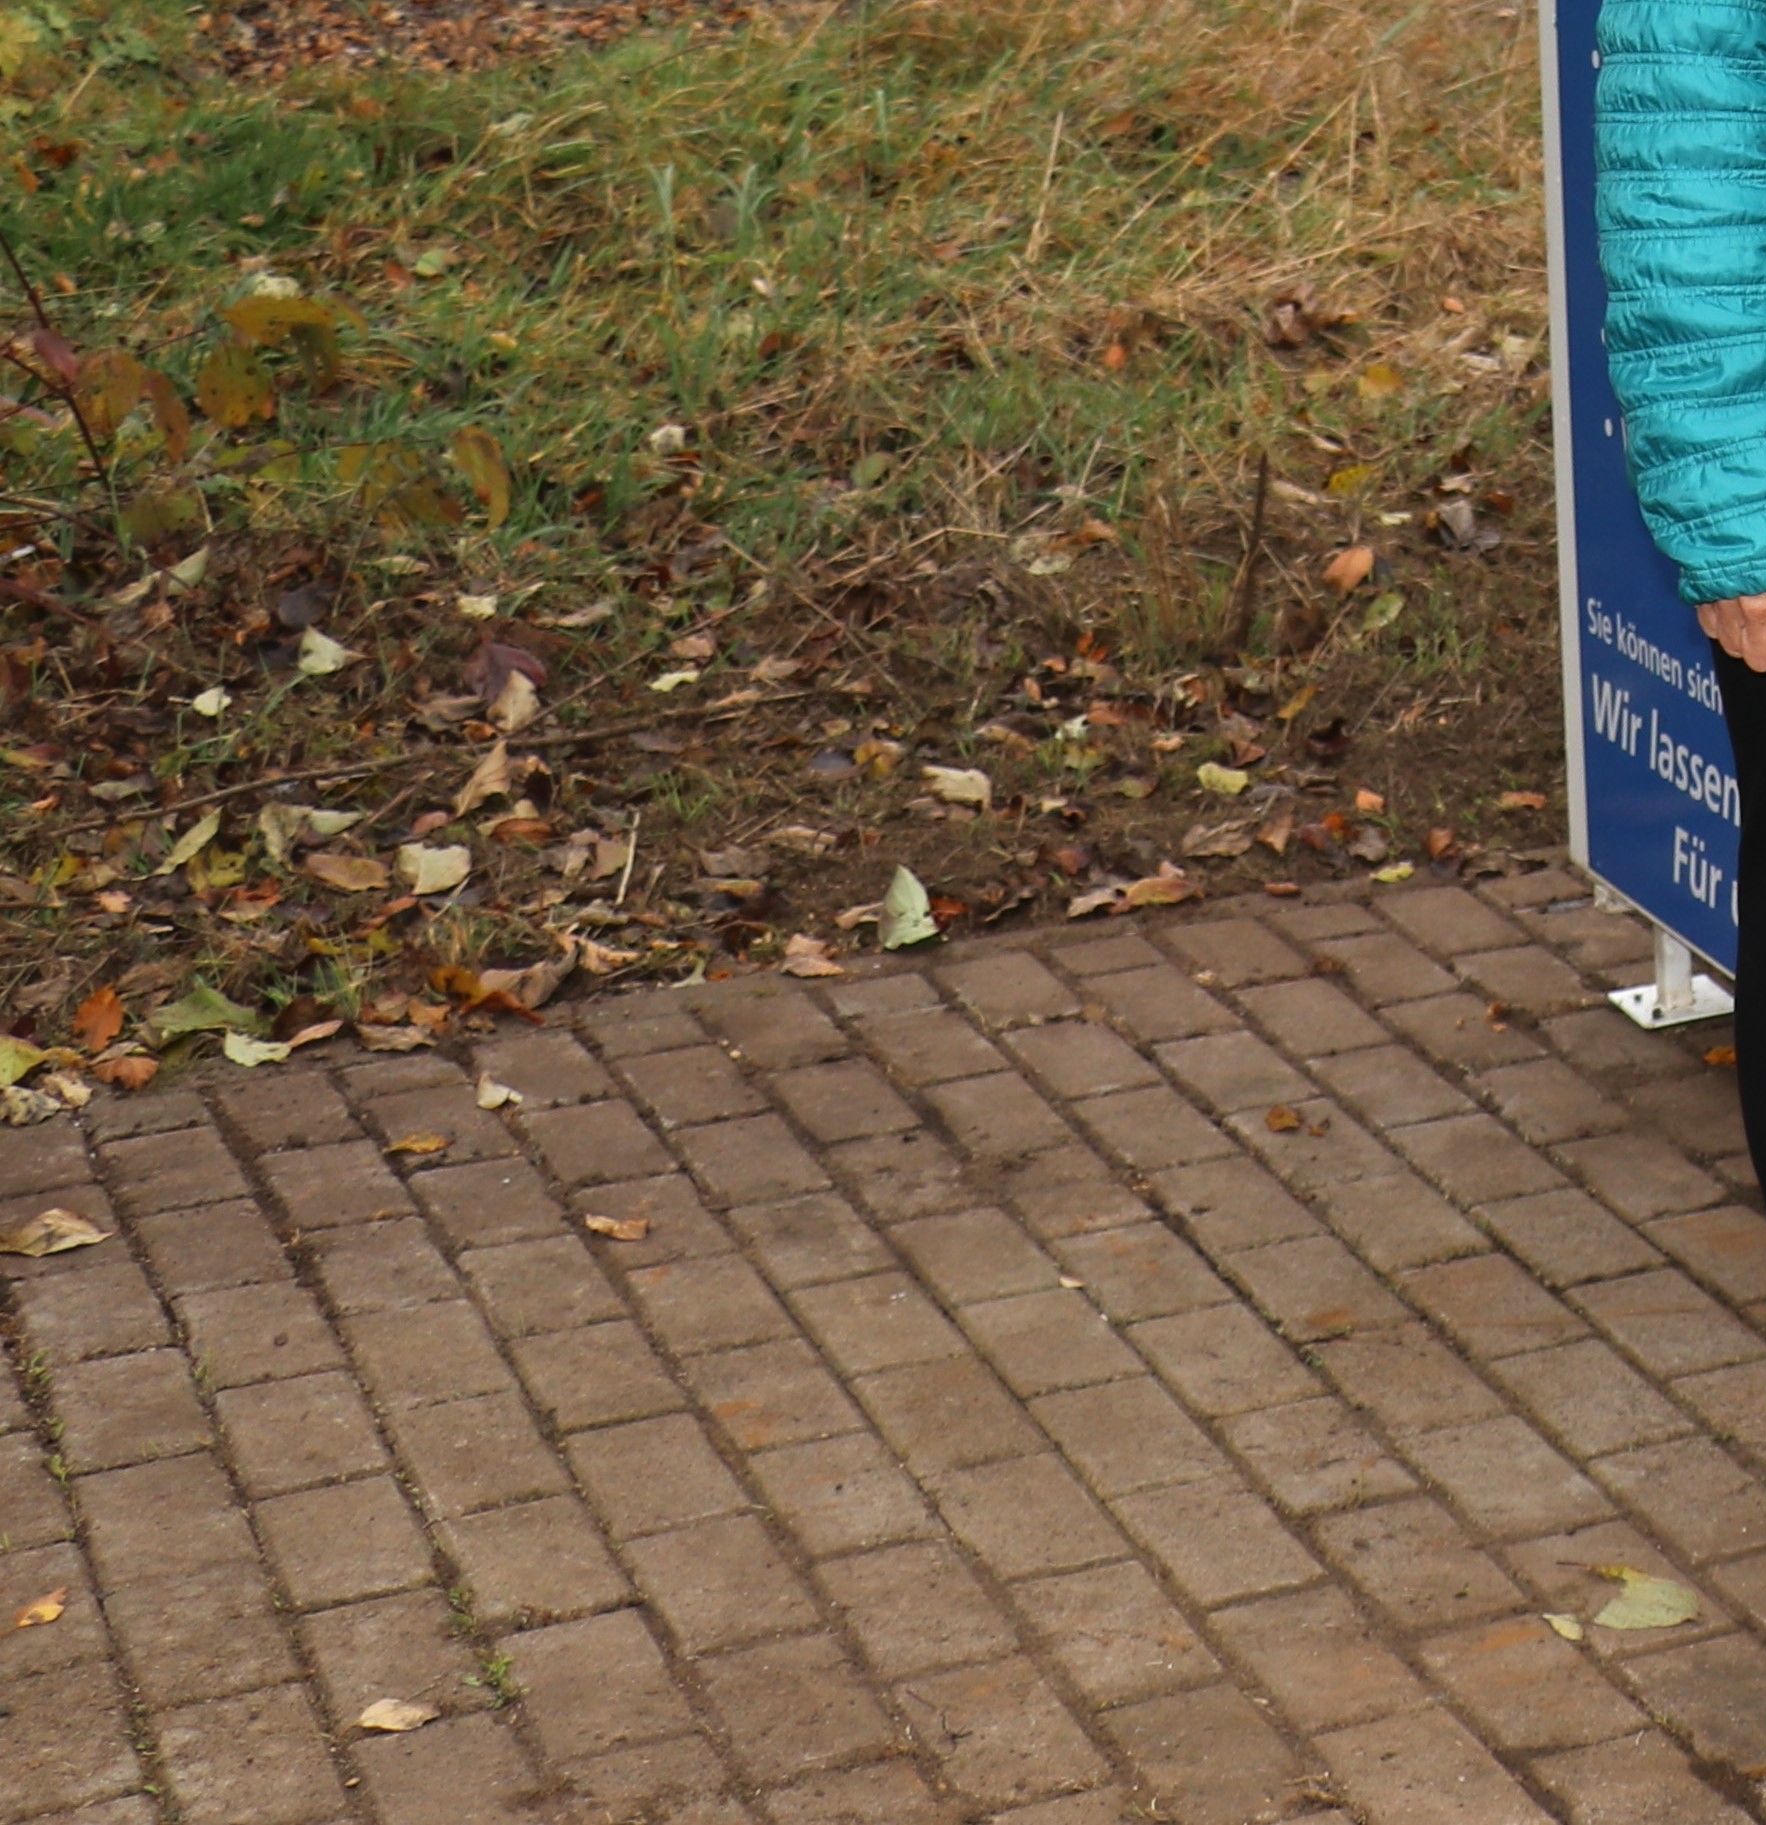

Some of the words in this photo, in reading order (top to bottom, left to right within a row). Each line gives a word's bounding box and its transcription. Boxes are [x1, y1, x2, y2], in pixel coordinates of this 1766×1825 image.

[1587, 597, 1613, 645] Sie
[1616, 612, 1683, 691] können
[1687, 662, 1724, 717] sich
[1592, 673, 1643, 757] Wir
[1649, 708, 1741, 828] lassen
[1672, 825, 1723, 910] Für
